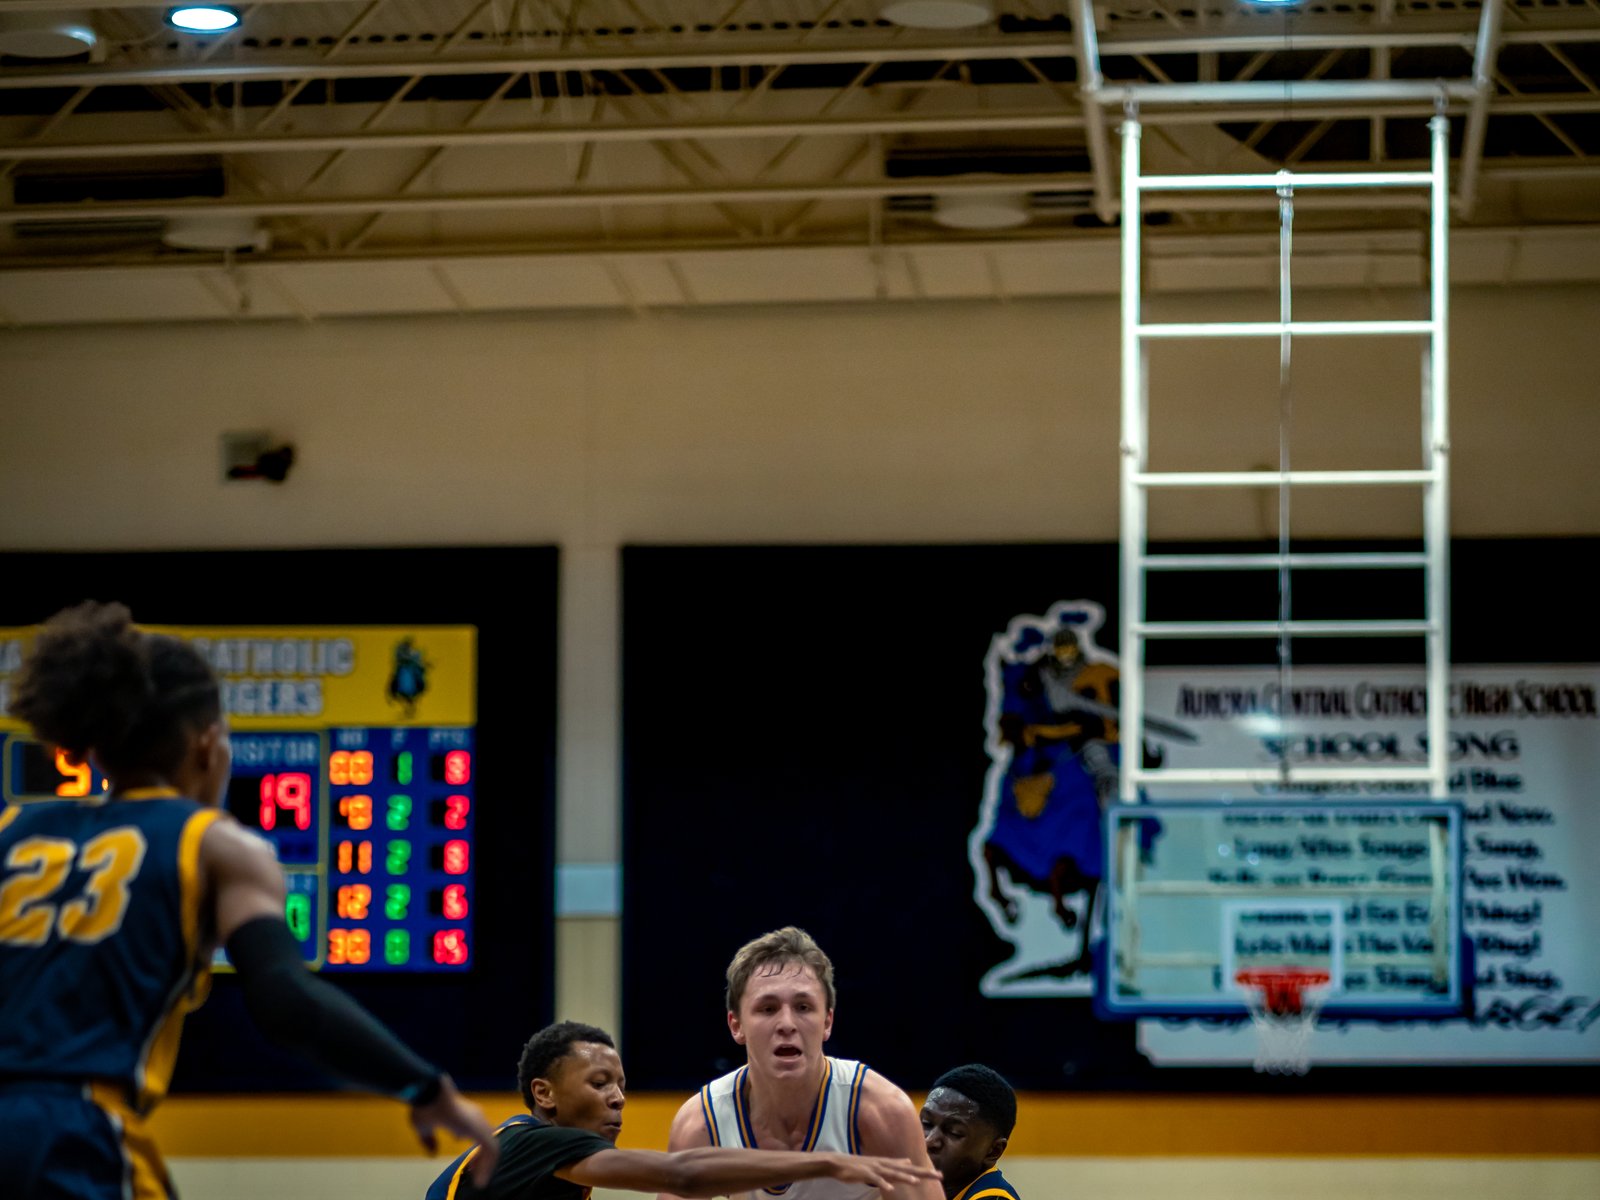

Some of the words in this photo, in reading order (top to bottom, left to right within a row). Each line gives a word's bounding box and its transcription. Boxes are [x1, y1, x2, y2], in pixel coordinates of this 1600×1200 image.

[1263, 682, 1352, 718] CNTRAL
[229, 738, 317, 766] ISITOR
[259, 772, 312, 831] 19
[386, 794, 413, 831] 2
[444, 795, 470, 831] 2
[386, 839, 412, 876] 2
[0, 827, 148, 948] 23
[385, 883, 411, 921] 2
